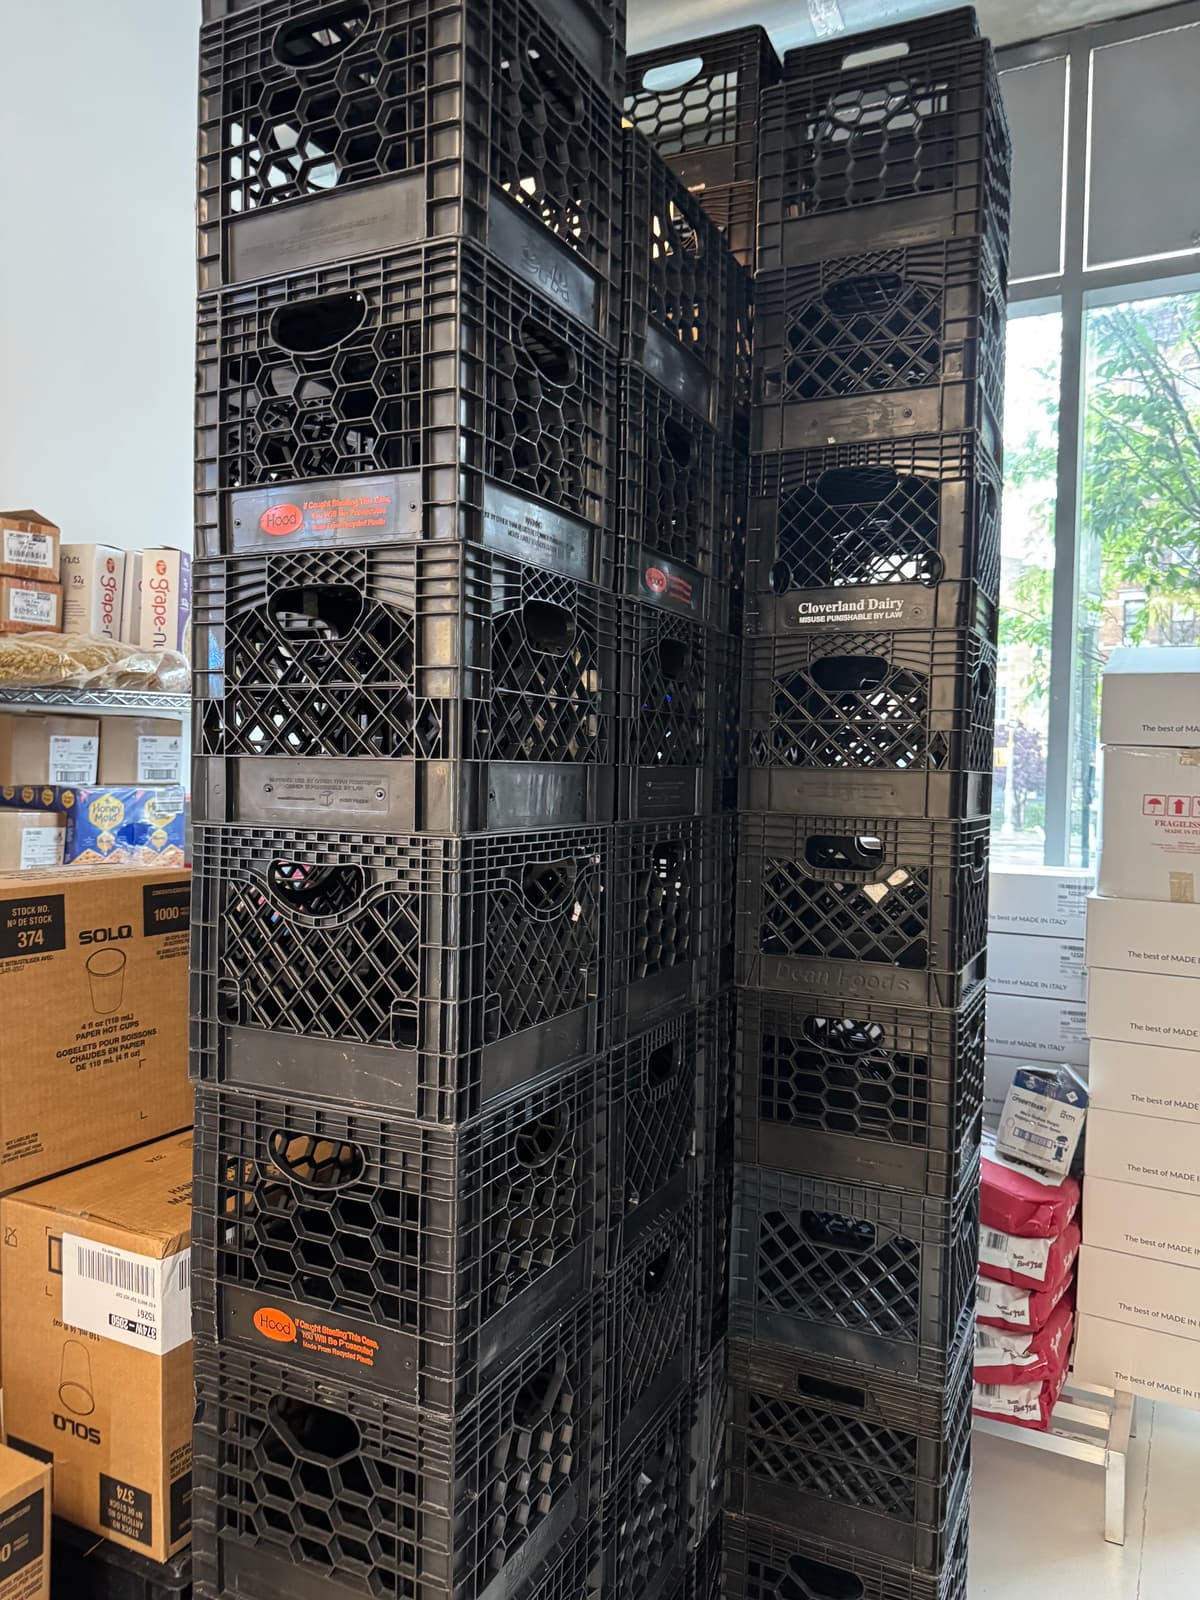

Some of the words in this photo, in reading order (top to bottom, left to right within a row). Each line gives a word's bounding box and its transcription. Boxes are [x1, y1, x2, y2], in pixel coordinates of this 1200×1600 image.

[266, 511, 297, 528] Hood
[798, 599, 865, 614] Cloverland
[867, 597, 904, 611] Dairy
[826, 613, 872, 622] PUNISHABLE
[885, 611, 903, 619] LAW
[1142, 724, 1156, 732] The
[1185, 725, 1200, 733] MA
[92, 806, 120, 816] Honey
[11, 904, 36, 917] STOCK
[37, 904, 50, 915] NO.
[153, 906, 179, 922] 1000
[18, 917, 28, 927] DE
[29, 915, 52, 926] STOCK
[1049, 918, 1068, 926] ITALY
[17, 929, 44, 948] 374
[79, 925, 133, 945] SOLO
[1127, 950, 1142, 959] The
[1143, 952, 1160, 960] best
[1171, 955, 1197, 964] MADE
[776, 960, 830, 986] Dean
[1019, 980, 1039, 988] MADE
[76, 1029, 101, 1041] PAPER
[102, 1025, 118, 1035] HOT
[119, 1020, 140, 1031] CUPS
[1129, 1022, 1144, 1030] The
[1145, 1024, 1161, 1033] best
[1173, 1028, 1199, 1037] MADE
[56, 1042, 97, 1058] GOBELETS
[99, 1036, 119, 1048] POUR
[121, 1028, 157, 1043] BOISSONS
[70, 1048, 106, 1064] CHAUDES
[108, 1045, 118, 1055] EN
[120, 1039, 146, 1051] PAPIER
[75, 1063, 86, 1072] DE
[103, 1057, 113, 1065] mL
[1131, 1094, 1145, 1102] The
[1146, 1096, 1163, 1105] best
[1174, 1100, 1199, 1110] MADE
[1128, 1163, 1141, 1172] The
[1142, 1166, 1158, 1175] best
[1169, 1170, 1195, 1181] MADE
[1124, 1234, 1139, 1243] The
[1140, 1237, 1156, 1247] best
[1167, 1243, 1192, 1254] MADE
[137, 1308, 156, 1322] 15261
[1118, 1302, 1133, 1311] The
[1133, 1306, 1150, 1316] best
[1160, 1312, 1186, 1324] MADE
[1187, 1318, 1197, 1326] IN
[260, 1313, 291, 1336] Hood
[300, 1320, 322, 1331] Caught
[321, 1326, 347, 1340] Stealing
[347, 1332, 361, 1343] This
[301, 1330, 313, 1340] You
[314, 1333, 327, 1345] Will
[328, 1337, 338, 1346] Be
[302, 1341, 317, 1350] Made
[317, 1345, 332, 1354] From
[332, 1348, 356, 1360] Recycled
[1114, 1371, 1129, 1381] The
[1129, 1376, 1145, 1385] best
[1146, 1380, 1155, 1388] of
[1156, 1382, 1182, 1394] MADE
[1183, 1388, 1193, 1397] IN
[53, 1413, 101, 1445] SOLO
[116, 1485, 135, 1505] 374
[110, 1499, 127, 1513] STOCK
[127, 1507, 135, 1516] DE
[121, 1524, 139, 1538] STOCK
